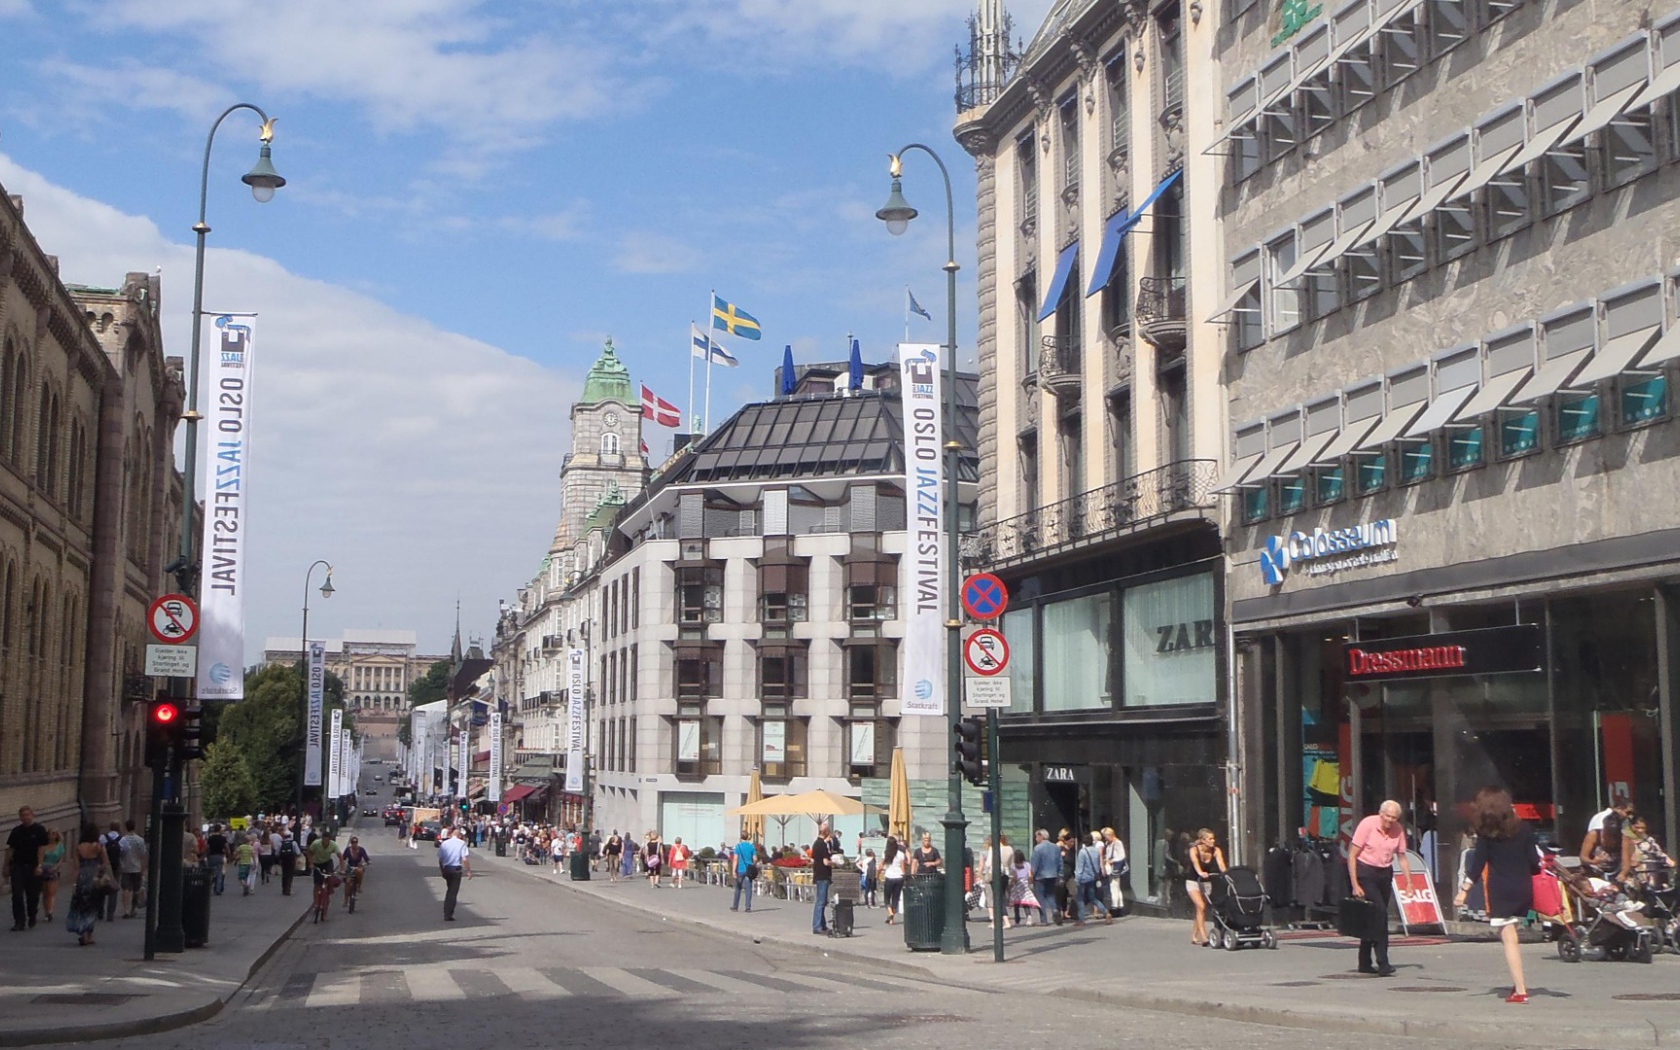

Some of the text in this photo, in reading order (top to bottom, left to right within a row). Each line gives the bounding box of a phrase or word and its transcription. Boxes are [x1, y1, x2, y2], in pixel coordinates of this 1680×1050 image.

[913, 407, 938, 616] OSLO JAZZFESTIVAL
[1288, 519, 1398, 560] Colosseum
[1350, 645, 1466, 675] Dressmann
[572, 673, 581, 695] OSLO
[907, 701, 938, 710] Statkraft
[1047, 767, 1075, 781] ZARA
